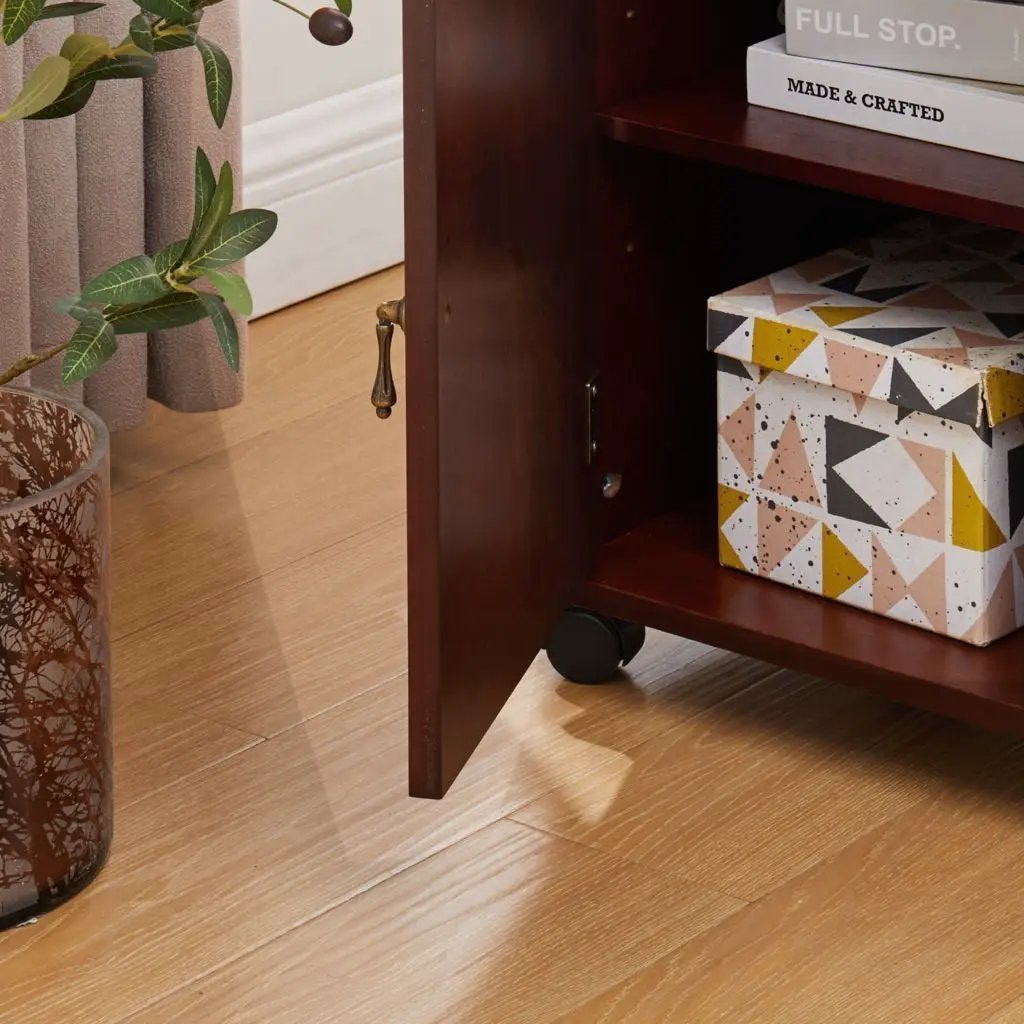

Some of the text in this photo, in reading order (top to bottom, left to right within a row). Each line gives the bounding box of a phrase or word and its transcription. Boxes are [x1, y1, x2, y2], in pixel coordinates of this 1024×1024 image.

[795, 7, 961, 50] FULL STOP.
[787, 77, 945, 123] MADE & CRAFTED
